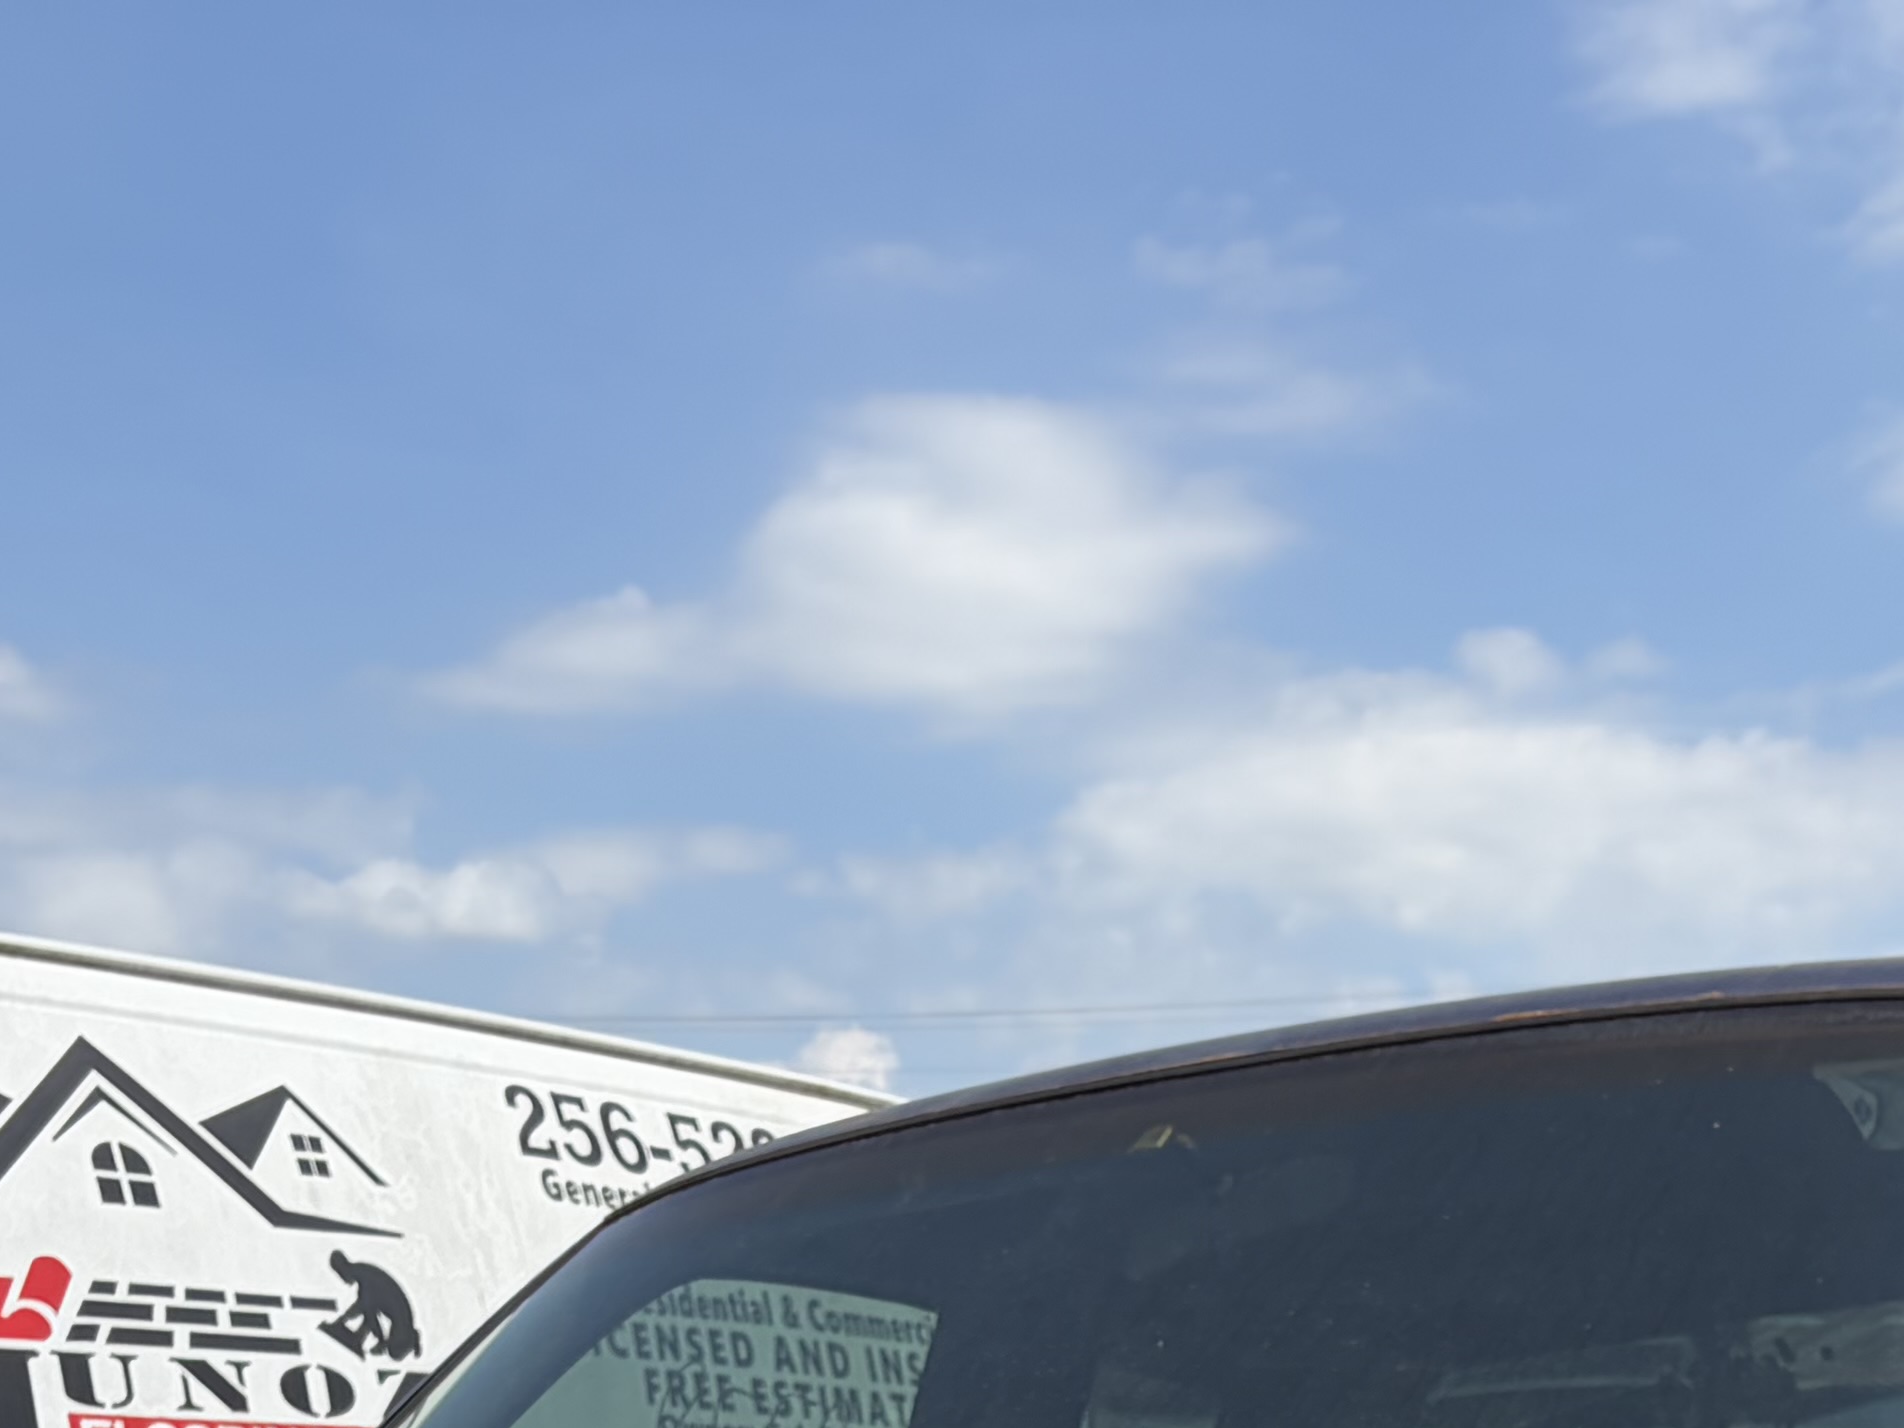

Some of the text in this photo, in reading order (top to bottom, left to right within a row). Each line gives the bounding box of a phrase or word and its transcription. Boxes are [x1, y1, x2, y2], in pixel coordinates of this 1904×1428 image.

[504, 1084, 775, 1174] 256-52
[541, 1168, 650, 1210] Gener
[643, 1284, 773, 1325] sidential
[781, 1294, 800, 1329] &
[775, 1335, 850, 1379] AND
[865, 1346, 923, 1386] INS
[644, 1368, 734, 1413] FREE
